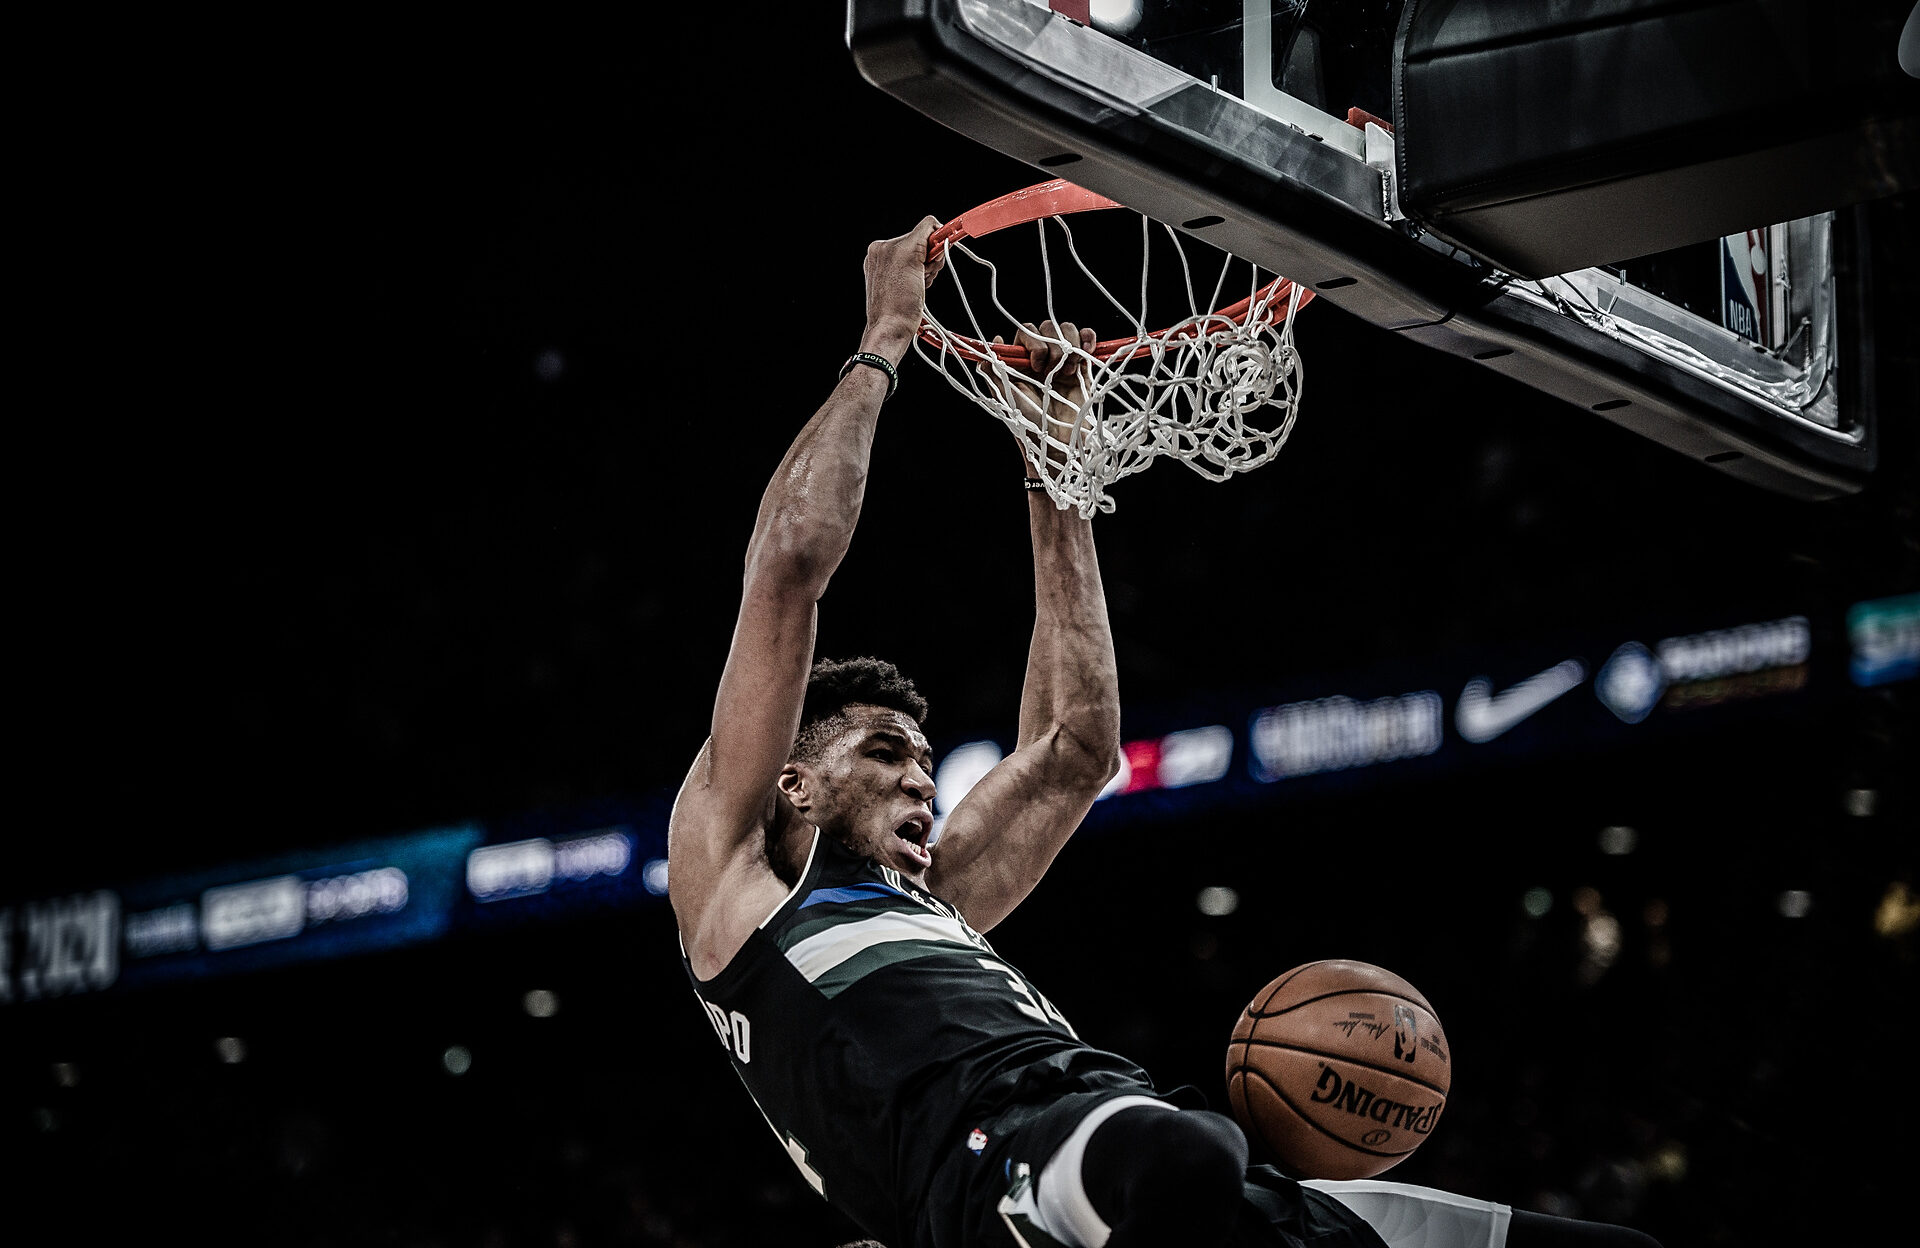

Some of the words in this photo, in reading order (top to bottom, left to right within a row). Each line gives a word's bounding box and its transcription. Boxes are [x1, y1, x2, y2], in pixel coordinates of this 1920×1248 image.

[1729, 299, 1753, 337] NBA
[694, 989, 750, 1064] PO
[1311, 1062, 1442, 1135] SPALDING
